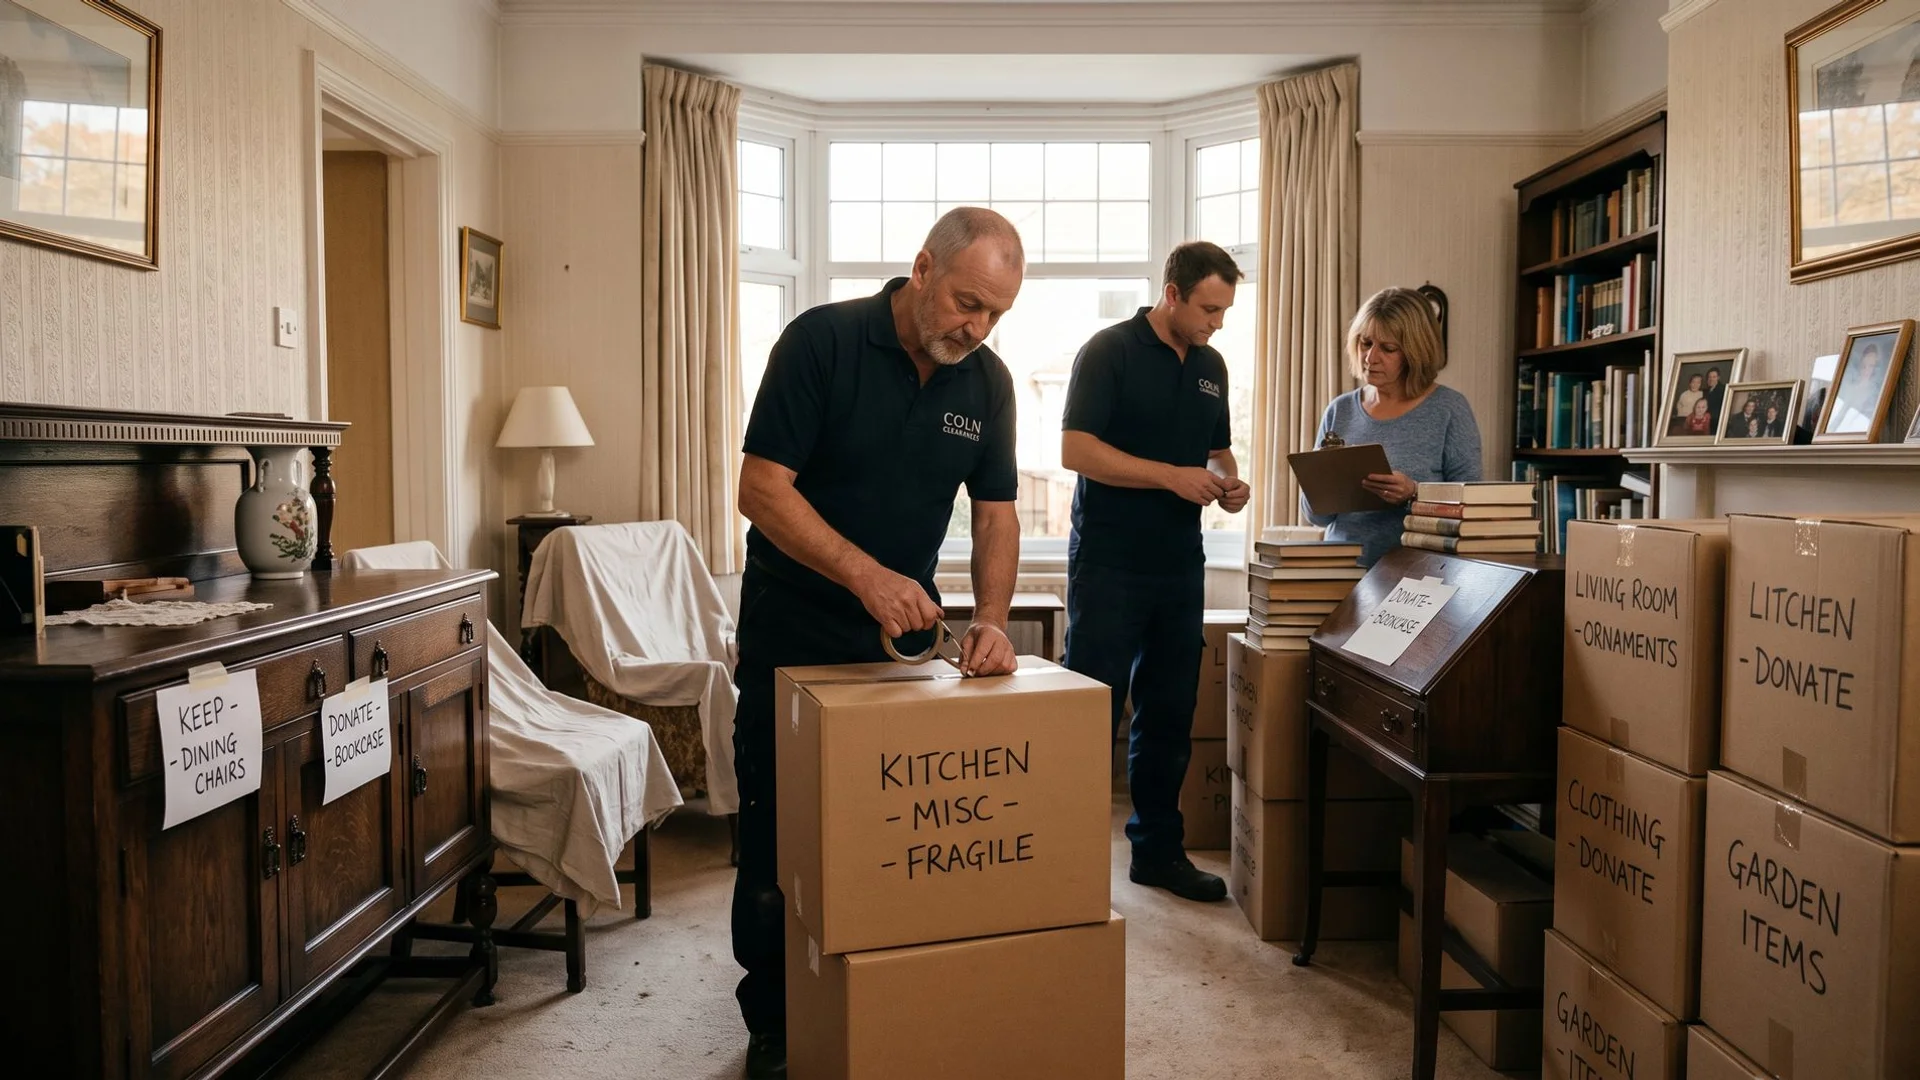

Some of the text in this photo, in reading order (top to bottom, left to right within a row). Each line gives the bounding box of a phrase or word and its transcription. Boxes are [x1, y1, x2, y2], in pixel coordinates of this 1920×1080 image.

[943, 412, 982, 434] COLN
[1575, 570, 1679, 620] LIVING ROOM
[1750, 581, 1855, 641] LITCHEN
[195, 758, 246, 795] CHAIRS
[881, 741, 1029, 791] KITCHEN
[914, 795, 993, 830] MISC
[1568, 779, 1666, 860] CLOTHING
[1728, 839, 1841, 937] GARDEN
[1742, 909, 1827, 996] ITEMS
[1557, 991, 1635, 1080] GARDEN
